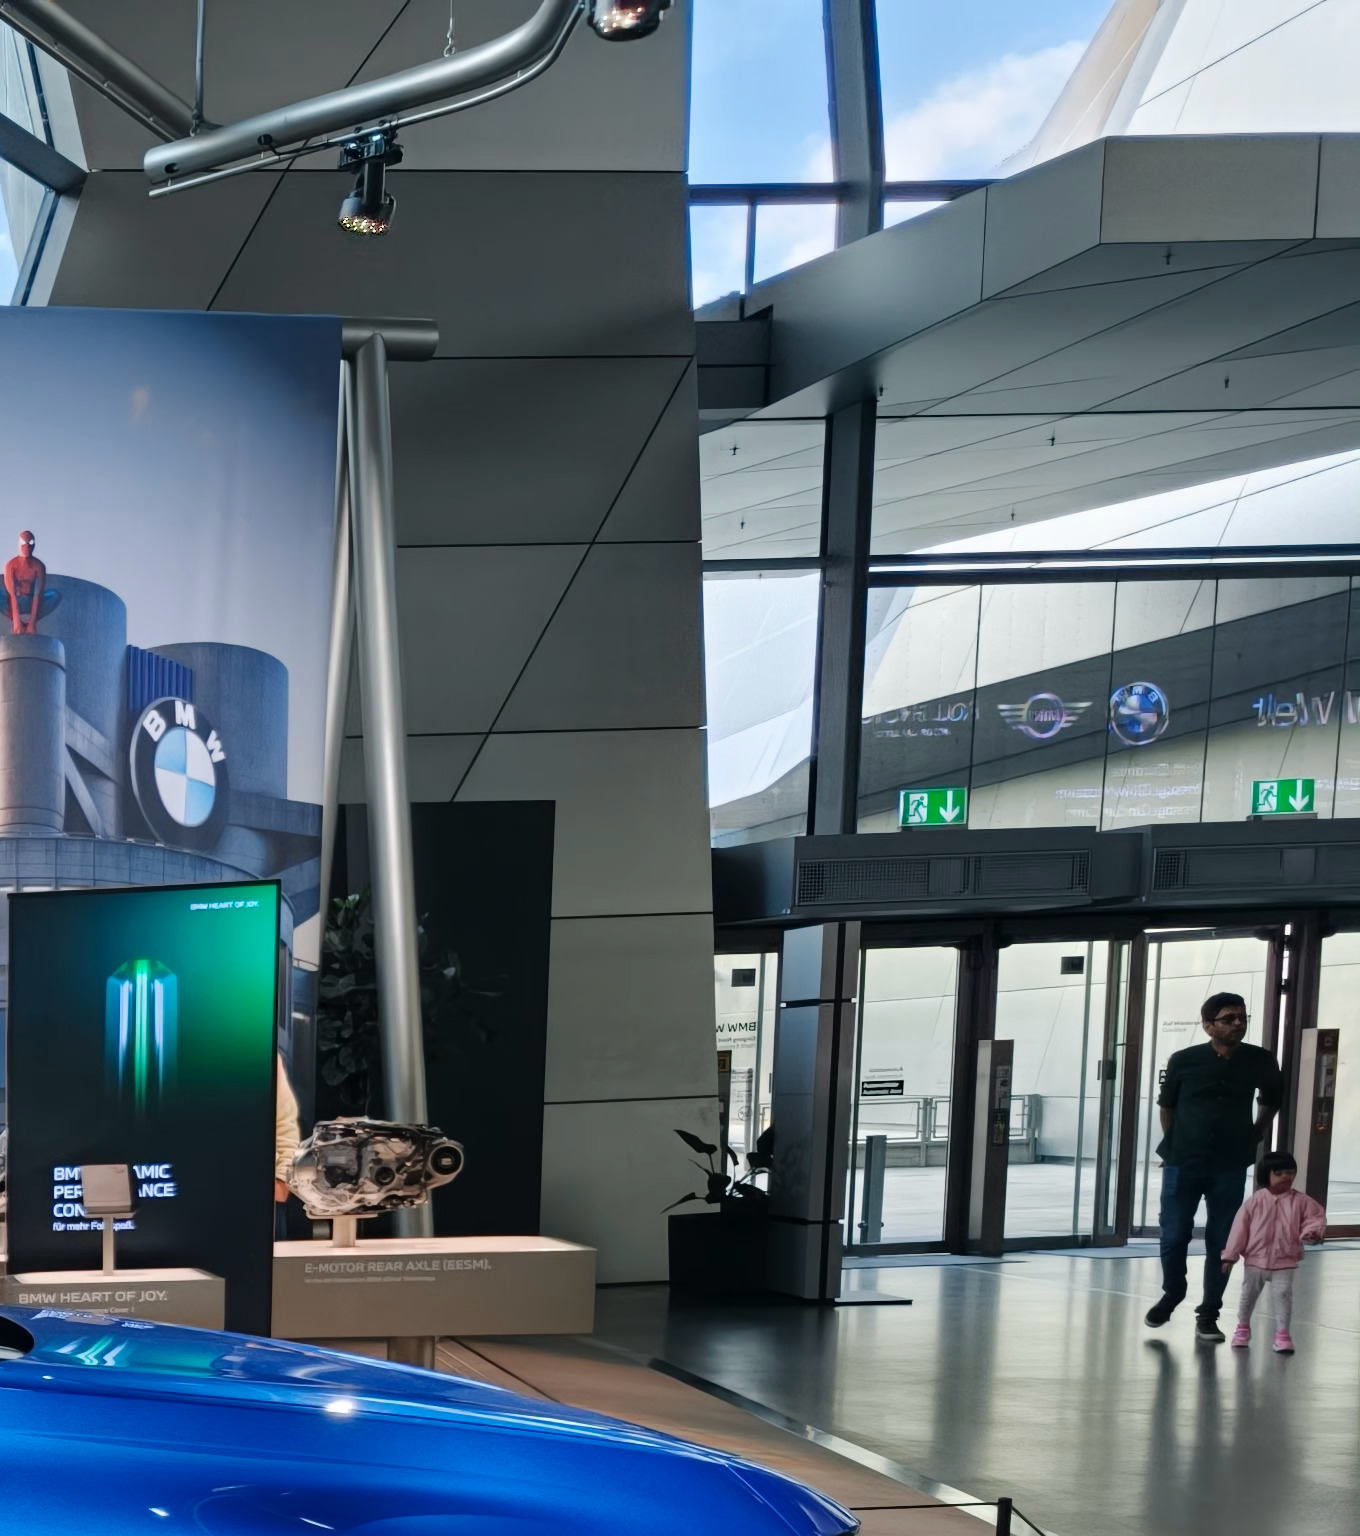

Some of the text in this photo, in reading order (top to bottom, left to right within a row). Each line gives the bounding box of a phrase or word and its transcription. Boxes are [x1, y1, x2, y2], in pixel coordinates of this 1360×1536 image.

[143, 700, 226, 763] BMW
[53, 1167, 82, 1181] BM
[53, 1221, 66, 1232] für
[67, 1221, 89, 1231] mehr
[305, 1258, 492, 1274] E-MOTOR REAR AXLE (EESM).
[18, 1290, 168, 1305] BMW HEART OF JOY.
